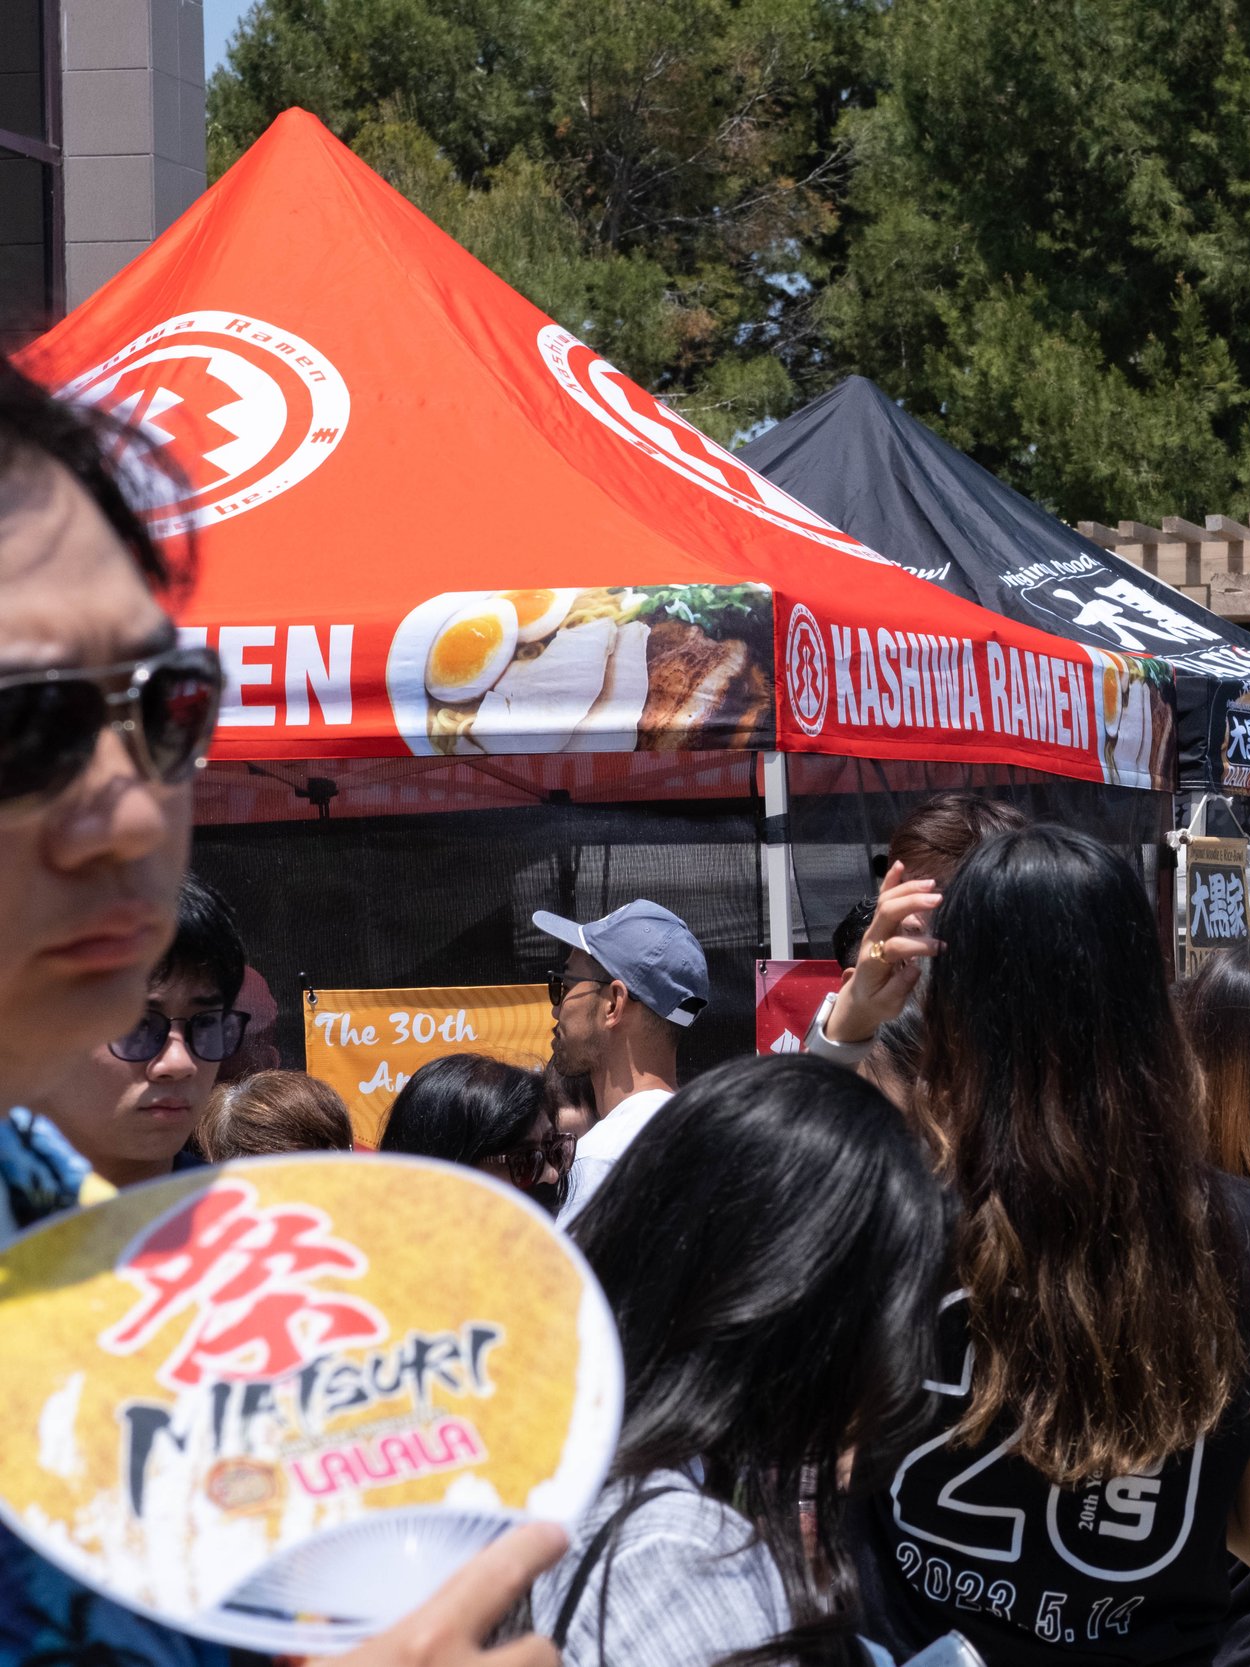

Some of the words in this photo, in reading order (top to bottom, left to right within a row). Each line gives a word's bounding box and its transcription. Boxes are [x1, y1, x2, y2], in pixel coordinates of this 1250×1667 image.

[224, 318, 328, 383] Ramen
[178, 624, 355, 728] EN
[830, 624, 985, 731] KASHIWA
[986, 640, 1089, 750] RAMEN
[1190, 871, 1247, 939] 大黒家
[314, 1011, 379, 1047] The
[388, 1009, 479, 1044] 30th
[124, 1328, 498, 1518] MATSURI
[291, 1423, 478, 1496] LALALA
[1086, 1464, 1104, 1488] Ye
[1078, 1494, 1099, 1532] 20th
